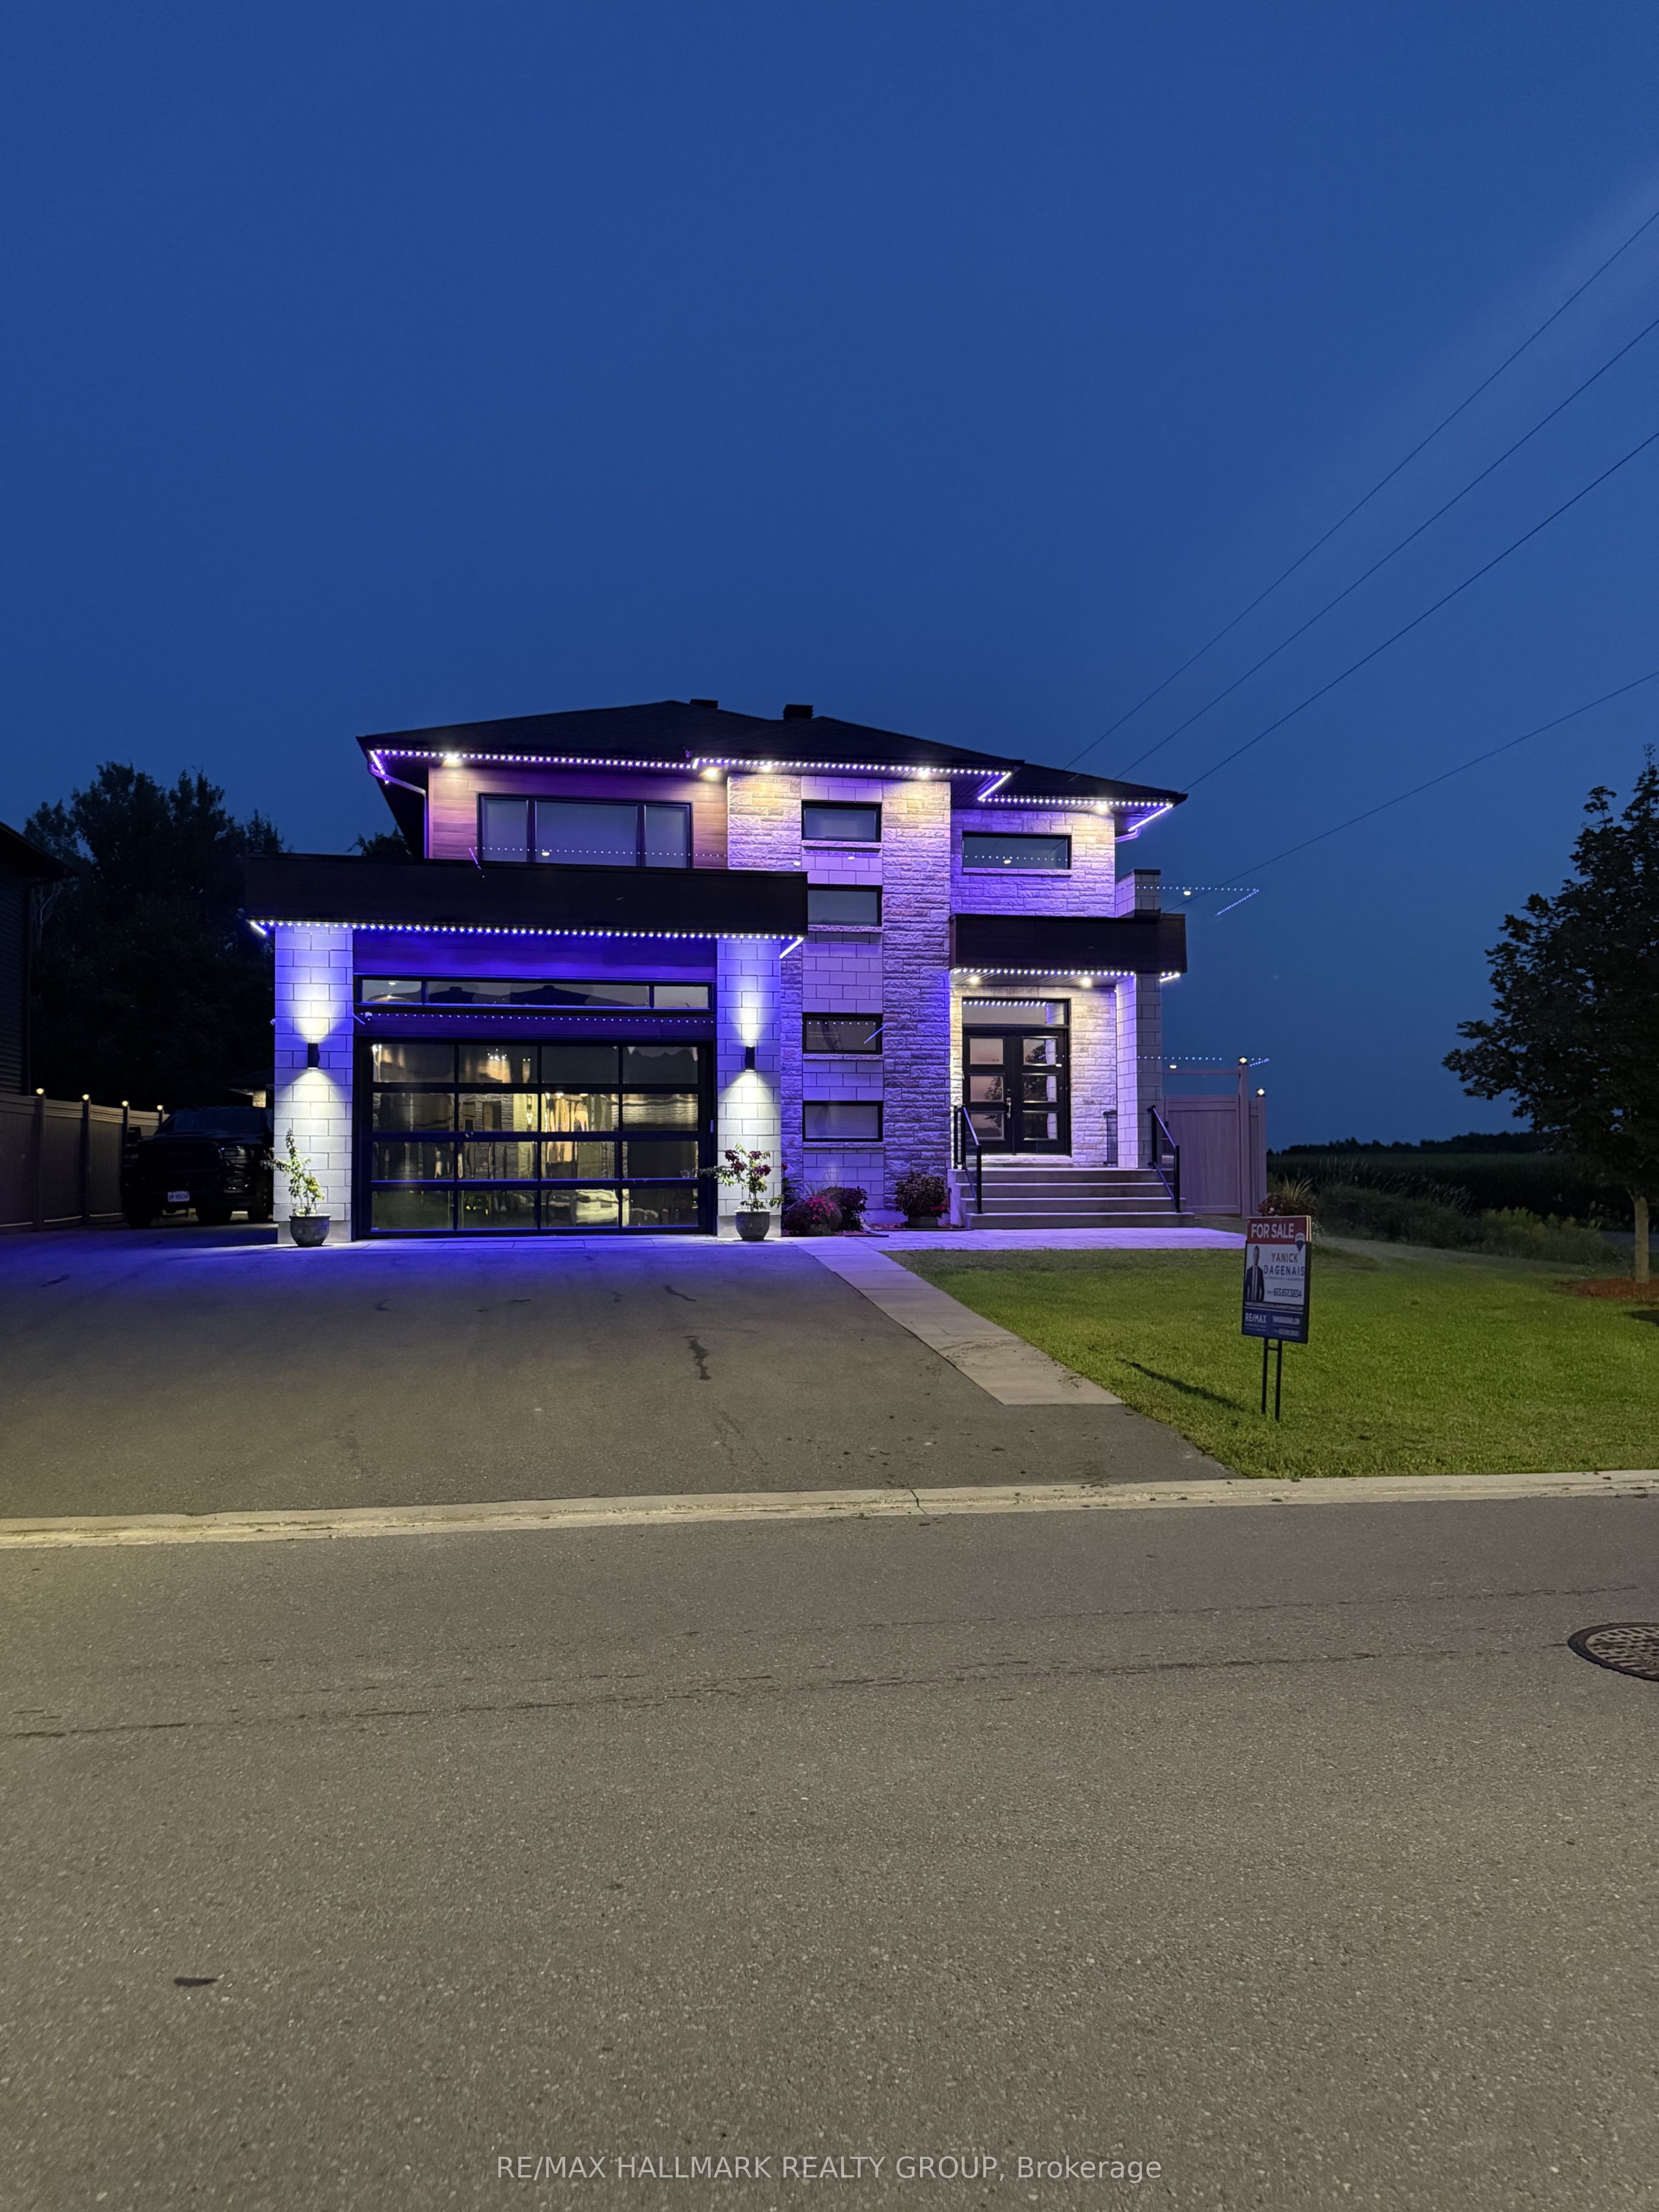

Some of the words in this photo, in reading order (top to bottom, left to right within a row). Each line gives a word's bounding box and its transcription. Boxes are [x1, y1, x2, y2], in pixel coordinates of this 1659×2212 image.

[1251, 1223, 1270, 1238] FOR
[1271, 1222, 1294, 1238] SALE
[1271, 1252, 1298, 1263] YANICK
[1263, 1264, 1305, 1276] DAGENAIS
[1244, 1312, 1267, 1324] RE/MAX
